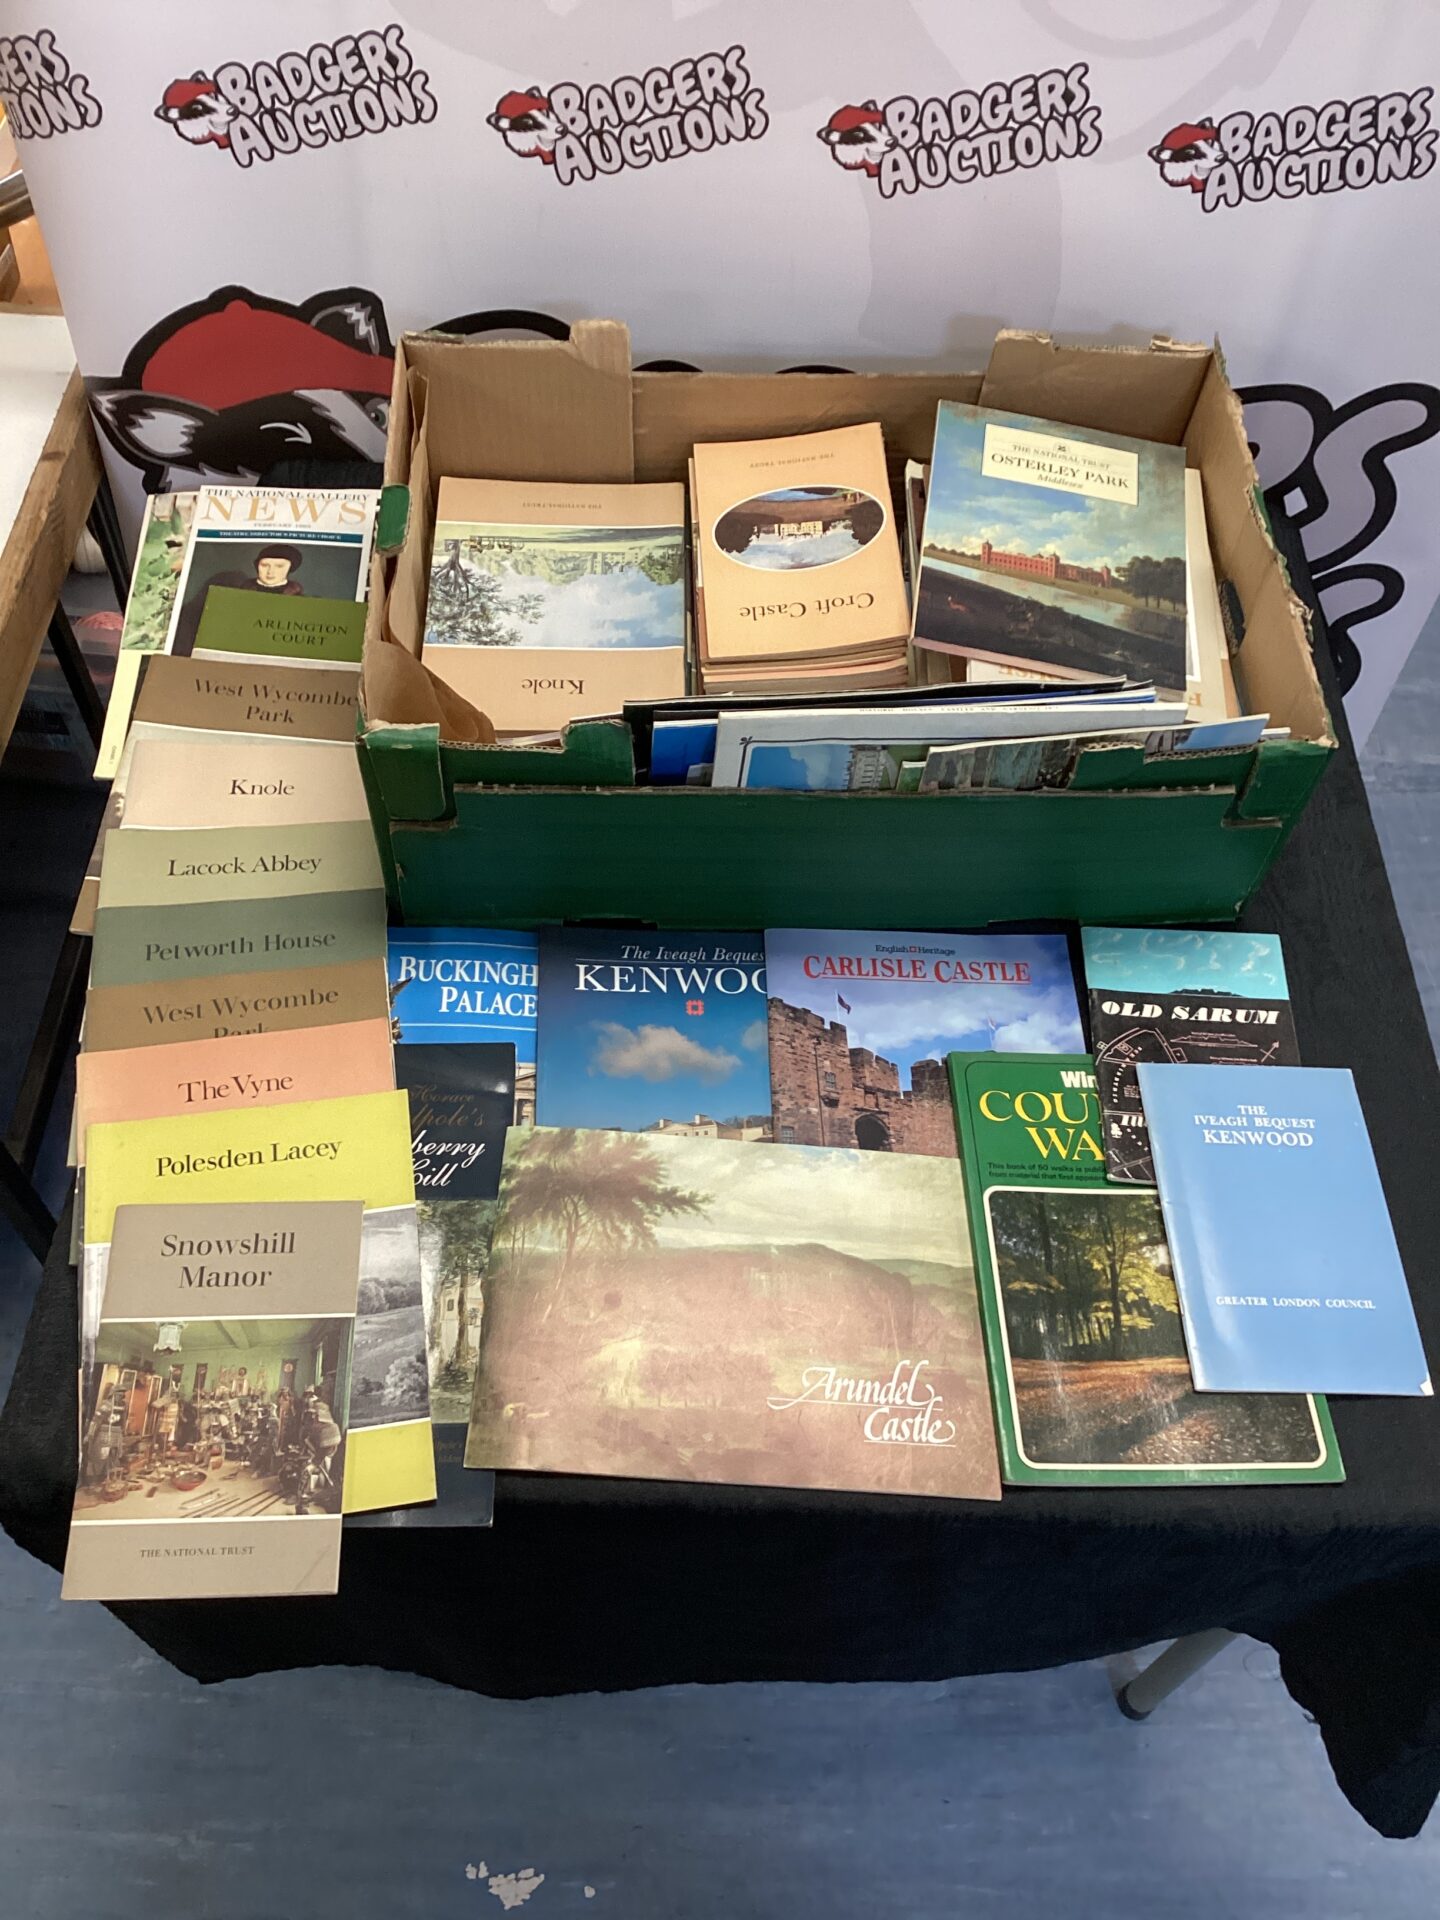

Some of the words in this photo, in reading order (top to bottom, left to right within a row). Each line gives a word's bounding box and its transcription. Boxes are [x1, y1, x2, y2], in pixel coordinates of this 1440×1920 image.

[213, 24, 412, 116] BADGERS
[548, 44, 750, 136] BADGERS
[883, 62, 1090, 149] BADGERS
[228, 69, 438, 168] AUCTIONS
[1220, 86, 1434, 164] BADGERS
[554, 88, 769, 186] AUCTIONS
[878, 106, 1102, 199] AUCTIONS
[1201, 129, 1440, 213] AUCTIONS
[1012, 444, 1031, 453] THE
[1034, 447, 1080, 463] NATIONAL
[991, 453, 1080, 478] OSTERLEY
[1085, 471, 1129, 488] PARK
[205, 488, 228, 497] THE
[240, 489, 302, 499] NATIONAL
[307, 492, 370, 501] GALLERY
[200, 495, 367, 525] NEWS
[739, 602, 807, 621] Castle
[816, 592, 875, 614] Croft
[253, 619, 348, 636] ARLINGTON
[272, 633, 328, 646] COURT
[194, 679, 244, 697] West
[521, 678, 585, 695] Knole
[247, 706, 295, 724] Park
[229, 779, 295, 796] Knole
[167, 857, 246, 876] Lacock
[251, 855, 322, 874] Abbey
[146, 937, 254, 961] Petworth
[264, 932, 336, 952] House
[620, 944, 651, 960] The
[656, 946, 706, 964] Iveagh
[712, 947, 765, 964] Beques
[875, 944, 909, 954] English
[917, 945, 956, 957] Heritage
[397, 956, 538, 987] BUCKINGH
[803, 955, 927, 979] CARLISLE
[933, 960, 1031, 984] CASTLE
[143, 1005, 203, 1025] West
[210, 988, 339, 1018] Wycombe
[439, 986, 538, 1017] PALACE
[1101, 1001, 1163, 1019] OLD
[1171, 1005, 1280, 1025] SARUM
[178, 1079, 229, 1103] The
[231, 1073, 294, 1099] Vyne
[1194, 1115, 1248, 1127] IVEAGH
[1254, 1116, 1316, 1130] BEQUEST
[1237, 1105, 1268, 1116] THE
[1203, 1129, 1314, 1147] KENWOOD
[156, 1149, 264, 1177] Polesden
[270, 1140, 342, 1162] Lacey
[1008, 1171, 1040, 1179] material
[160, 1232, 295, 1257] Snowshill
[178, 1266, 272, 1288] Manor
[1216, 1296, 1268, 1307] GREATER
[1272, 1297, 1321, 1308] LONDON
[1325, 1298, 1377, 1311] COUNCIL
[766, 1360, 943, 1410] Arundel
[863, 1396, 956, 1444] Castle
[140, 1549, 161, 1558] THE
[164, 1547, 217, 1557] NATIONAL
[220, 1546, 256, 1555] TRUST
